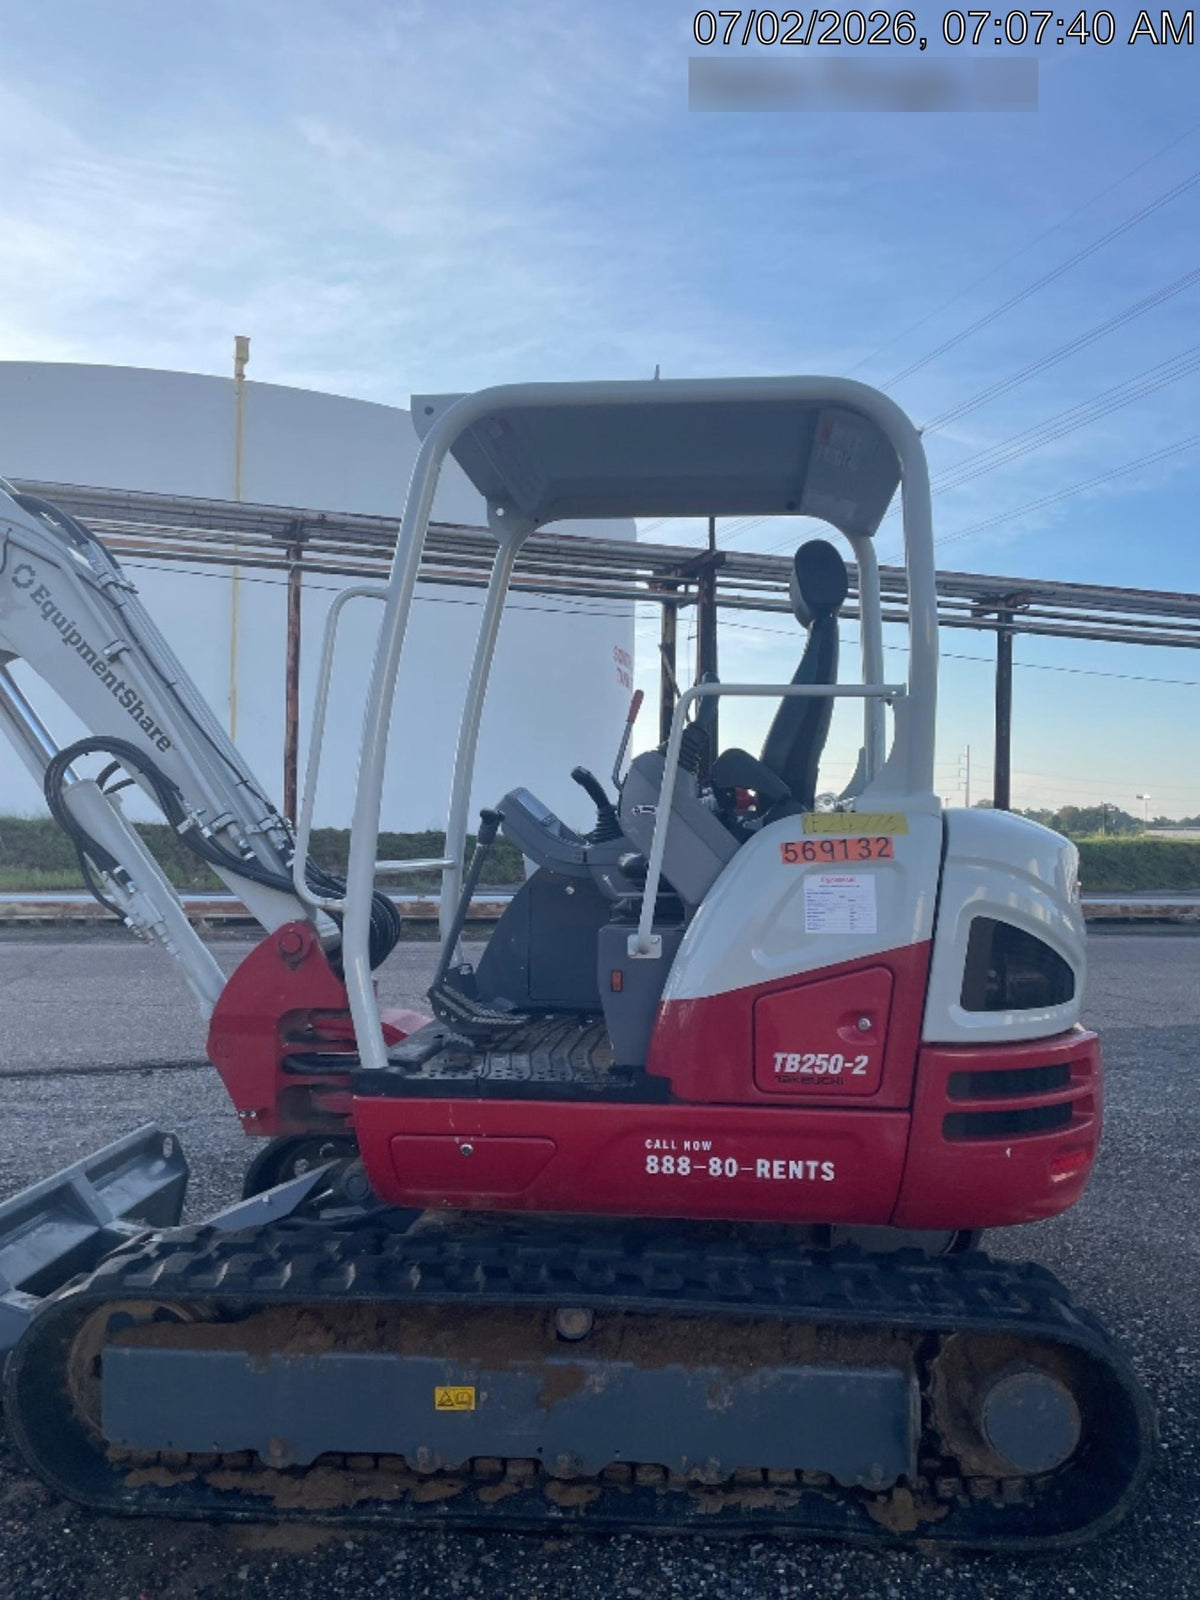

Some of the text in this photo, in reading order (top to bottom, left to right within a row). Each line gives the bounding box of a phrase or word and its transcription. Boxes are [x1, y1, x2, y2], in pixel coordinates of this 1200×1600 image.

[30, 584, 172, 753] EquipmentShare
[784, 837, 891, 864] 569132
[773, 1052, 870, 1076] TB250-2
[645, 1139, 713, 1151] CALL NOW
[645, 1154, 836, 1182] 888-80-RENTS
